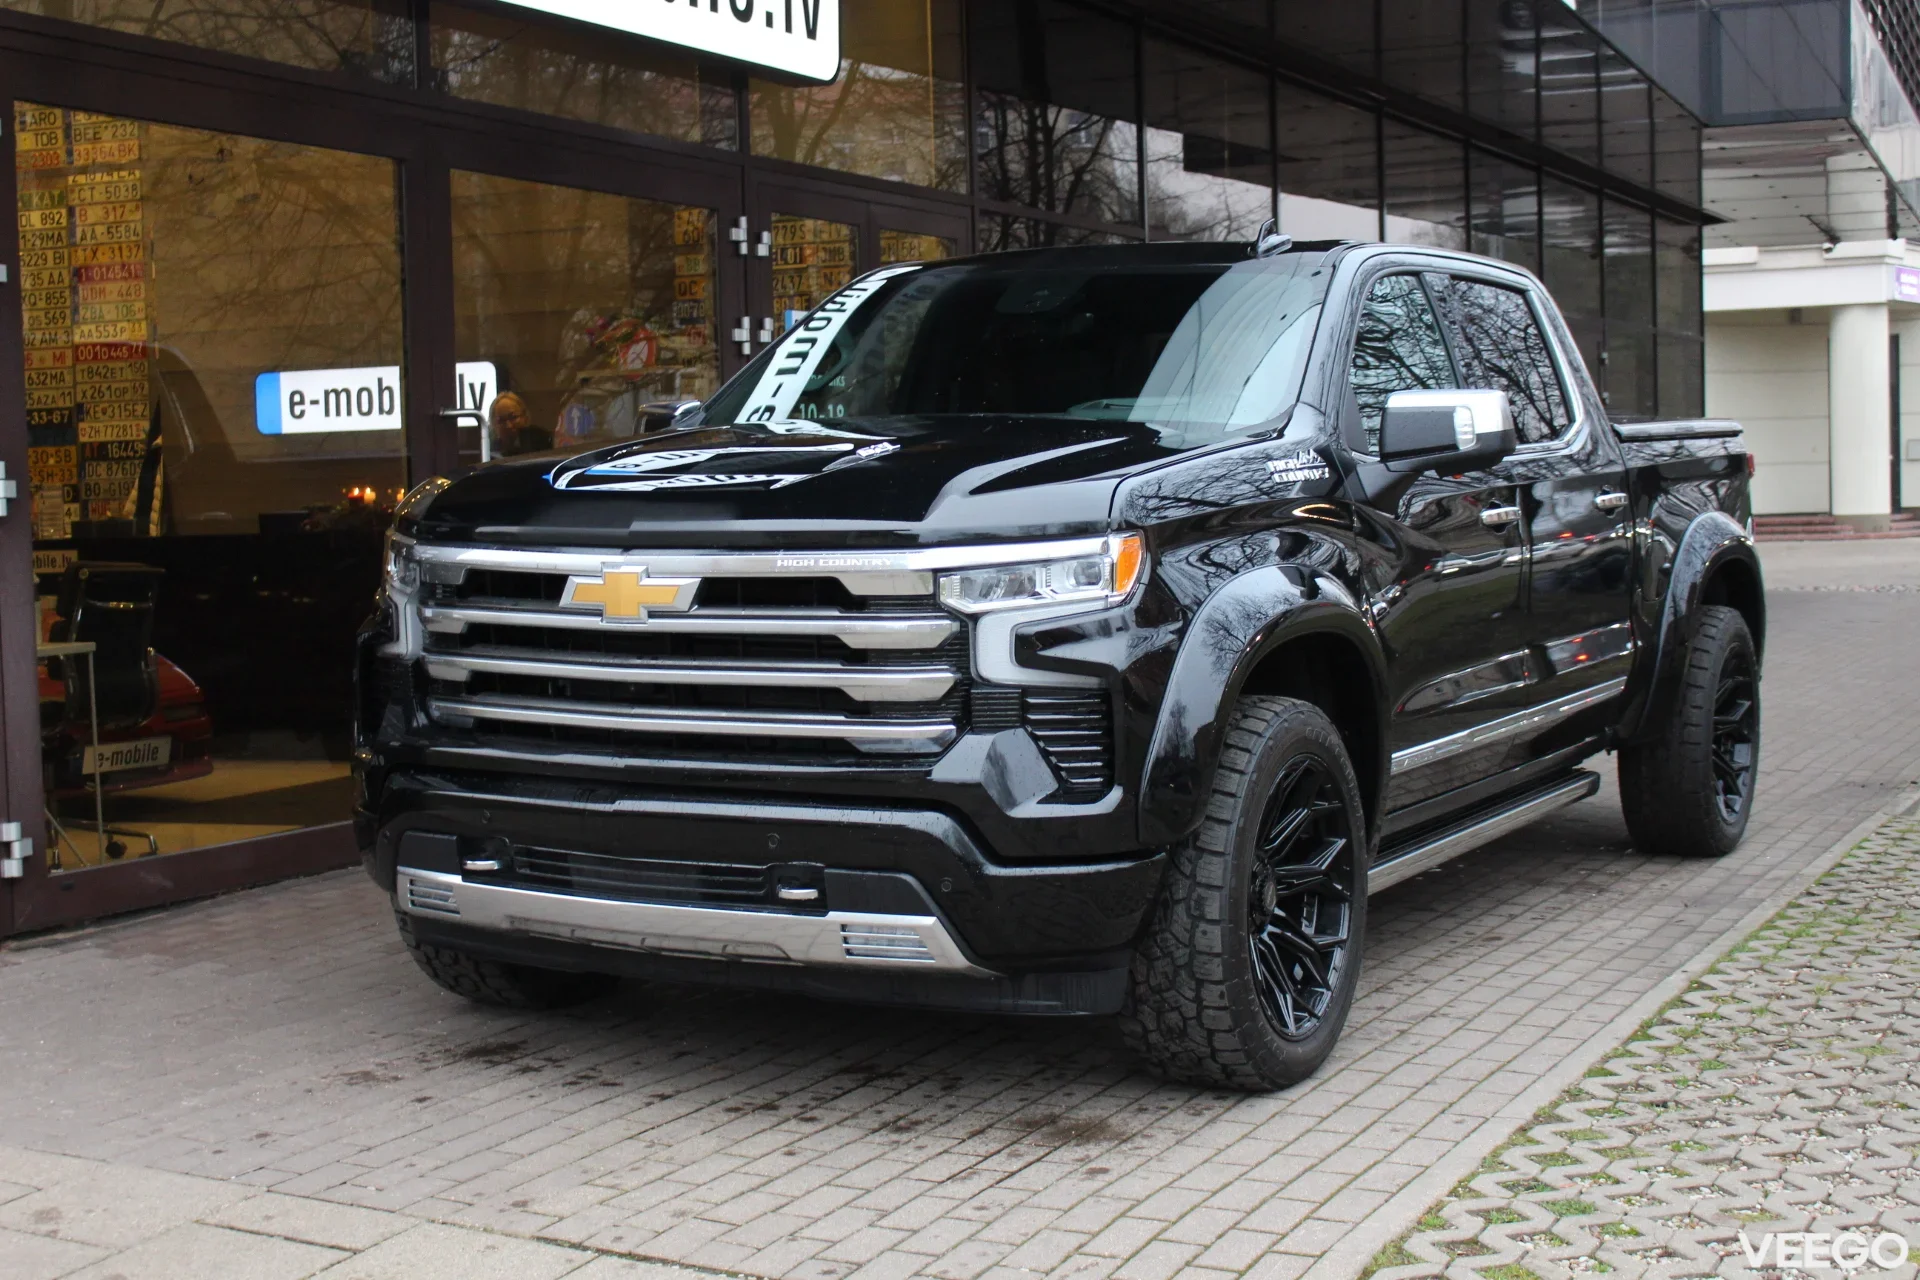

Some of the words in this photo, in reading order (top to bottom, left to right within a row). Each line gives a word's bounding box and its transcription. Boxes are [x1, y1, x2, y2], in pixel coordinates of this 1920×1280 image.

[40, 210, 63, 225] 892
[776, 558, 815, 568] HIGH
[819, 557, 892, 567] COUNTRY
